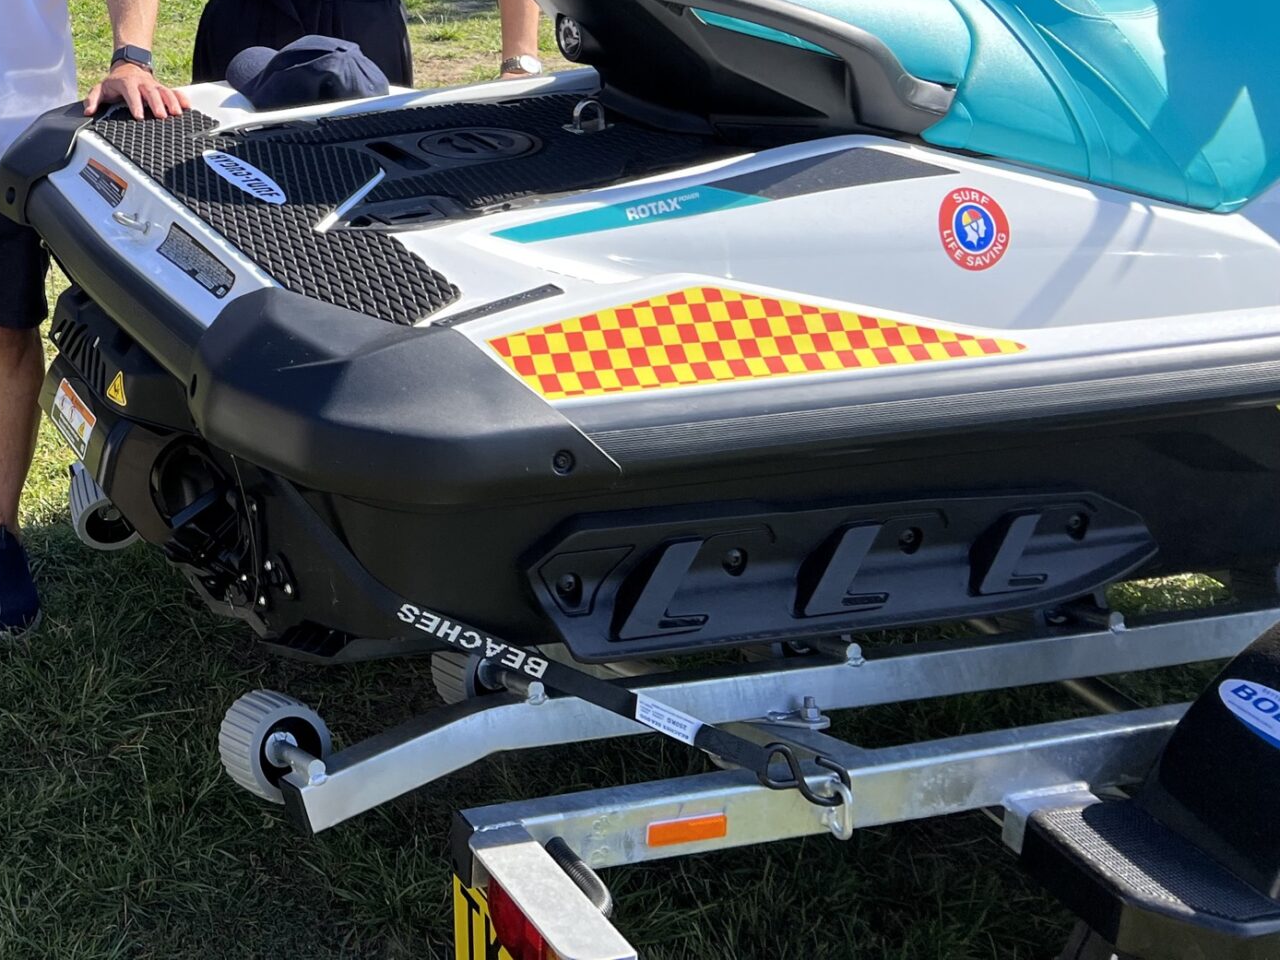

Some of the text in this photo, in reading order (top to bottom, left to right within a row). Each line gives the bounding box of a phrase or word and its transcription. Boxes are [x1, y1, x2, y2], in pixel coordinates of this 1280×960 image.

[625, 197, 682, 221] ROTAX
[952, 190, 991, 205] SURF
[943, 230, 1007, 267] LIFE SAVING
[396, 603, 549, 679] BEACHES
[1229, 684, 1280, 724] BO
